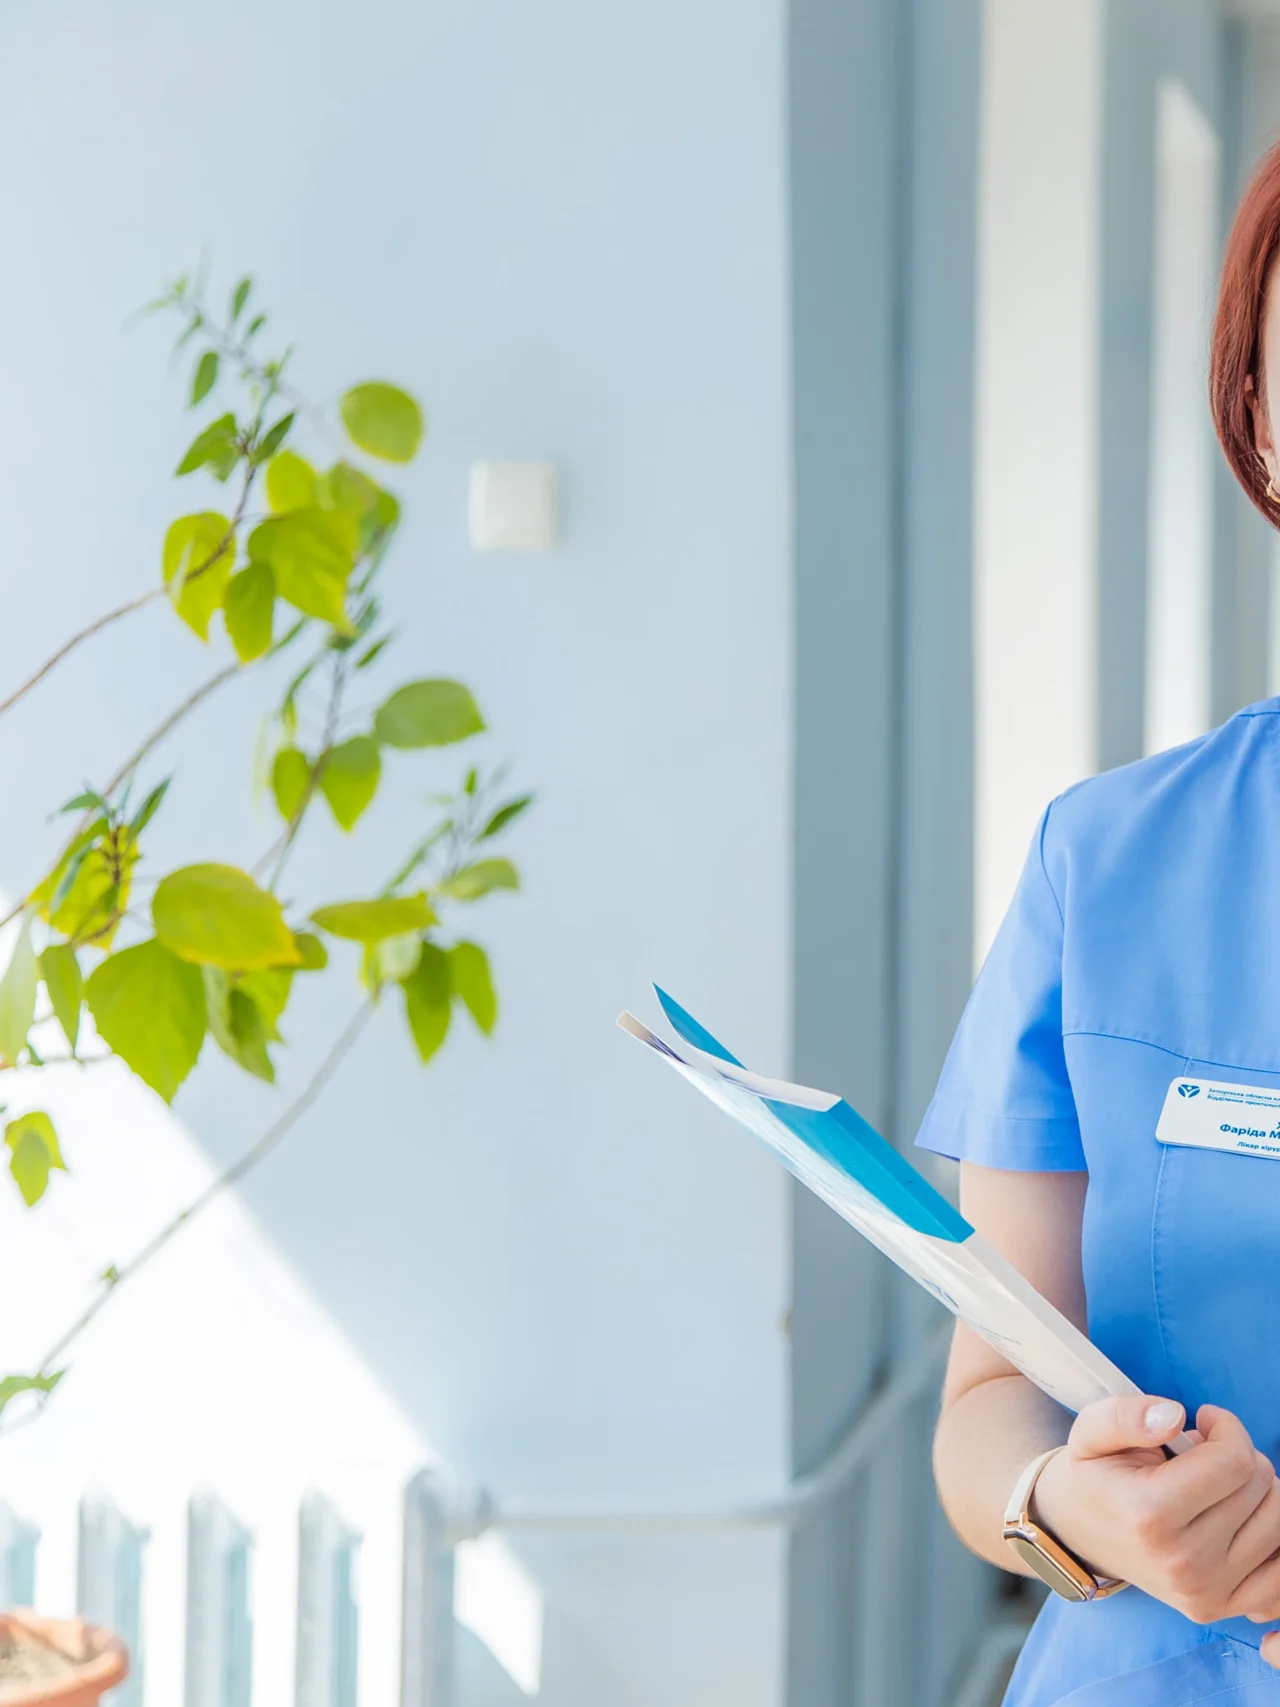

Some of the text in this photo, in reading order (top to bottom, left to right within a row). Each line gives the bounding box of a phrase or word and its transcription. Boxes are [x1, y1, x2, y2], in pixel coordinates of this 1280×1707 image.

[1208, 1088, 1244, 1097] Запорізька
[1207, 1094, 1244, 1103] Відділення
[1219, 1124, 1266, 1138] Фаріда
[1237, 1141, 1259, 1150] Лікар
